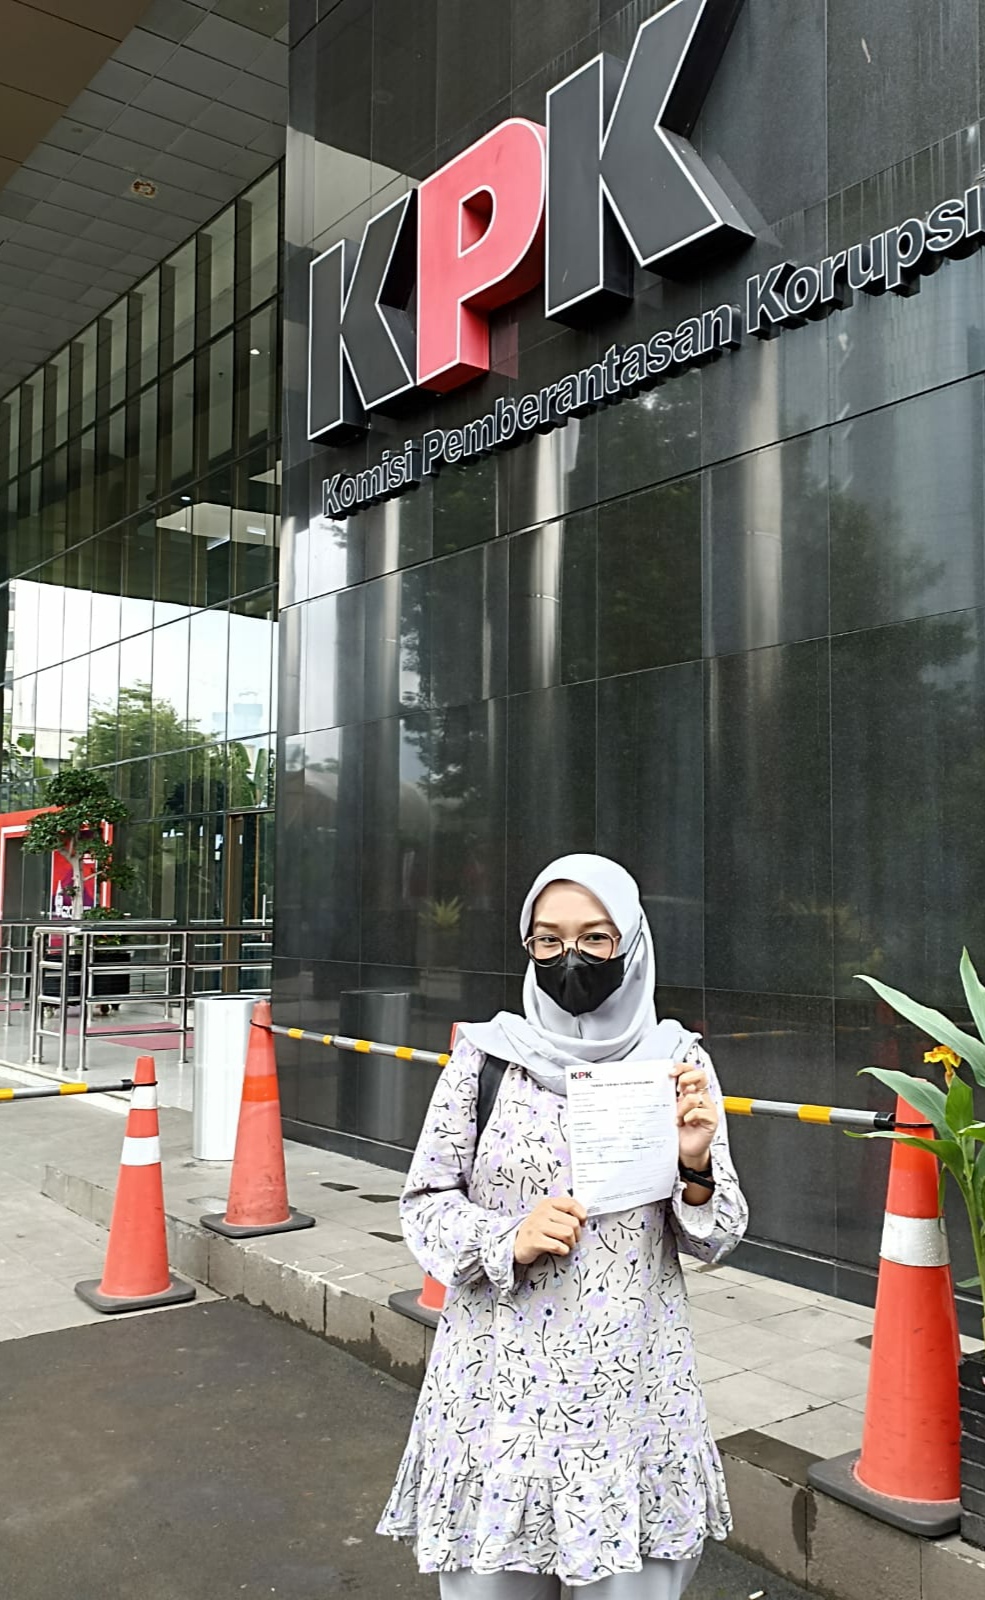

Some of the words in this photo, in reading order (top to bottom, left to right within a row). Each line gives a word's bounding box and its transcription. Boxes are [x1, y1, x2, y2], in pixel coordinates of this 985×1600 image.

[307, 0, 724, 442] KPK
[321, 440, 413, 518] Komisi
[422, 304, 733, 475] Pemberantasan
[746, 185, 982, 334] Korupsi
[570, 1071, 593, 1080] KPK
